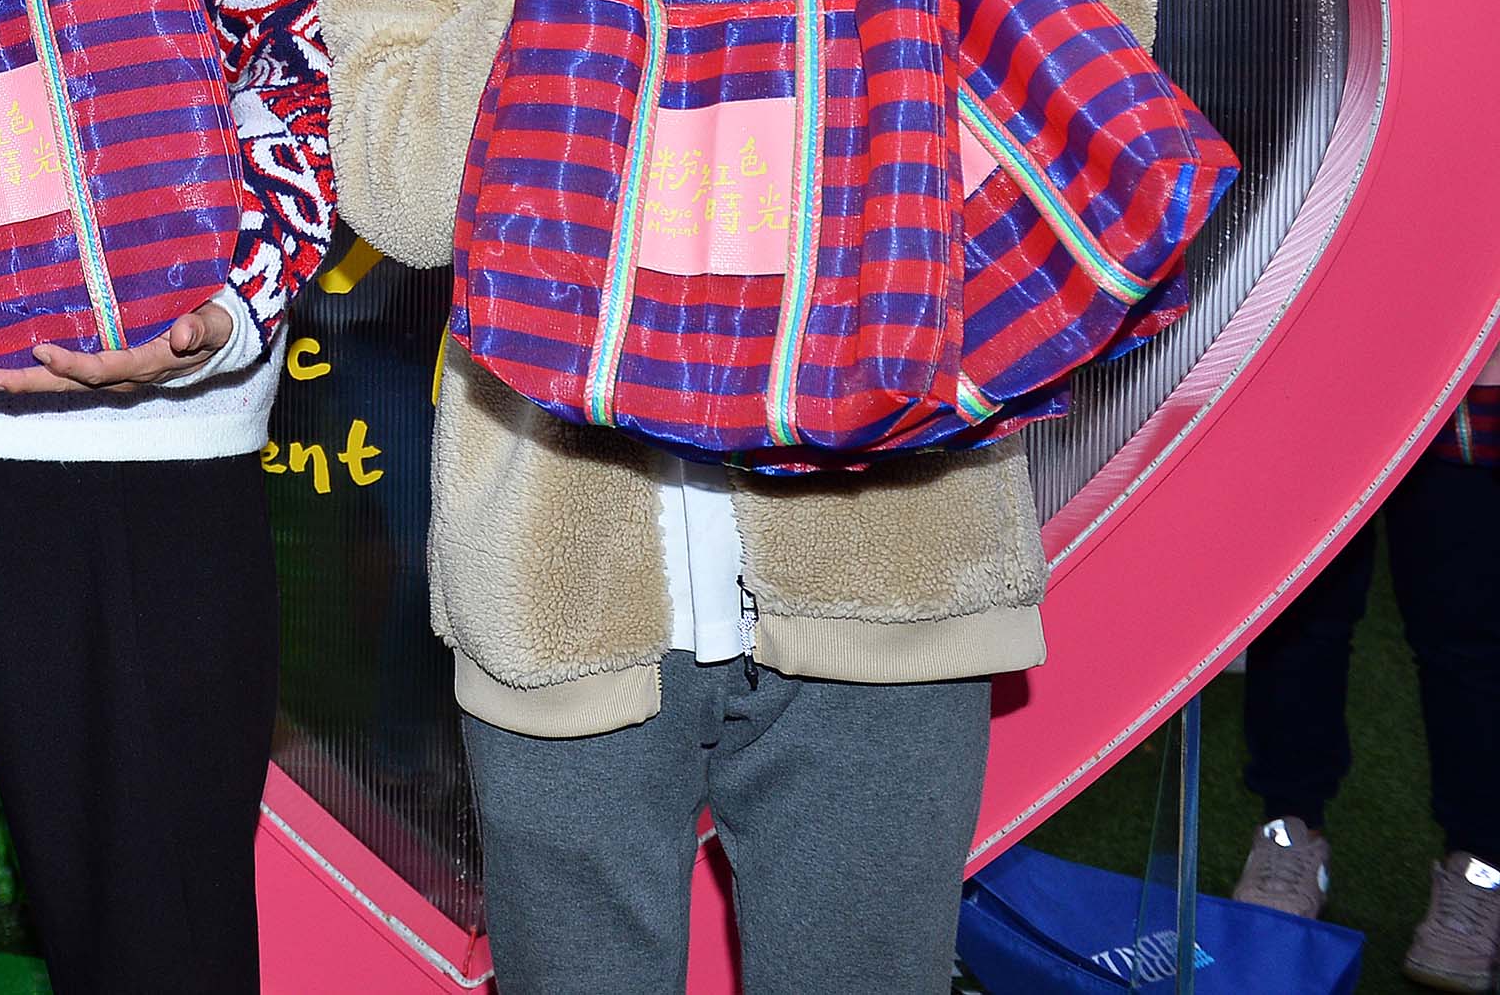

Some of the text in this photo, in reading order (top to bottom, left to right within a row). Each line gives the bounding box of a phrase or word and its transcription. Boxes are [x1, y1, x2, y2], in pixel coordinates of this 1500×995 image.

[650, 135, 768, 204] 粉紅色
[260, 418, 385, 494] ent
